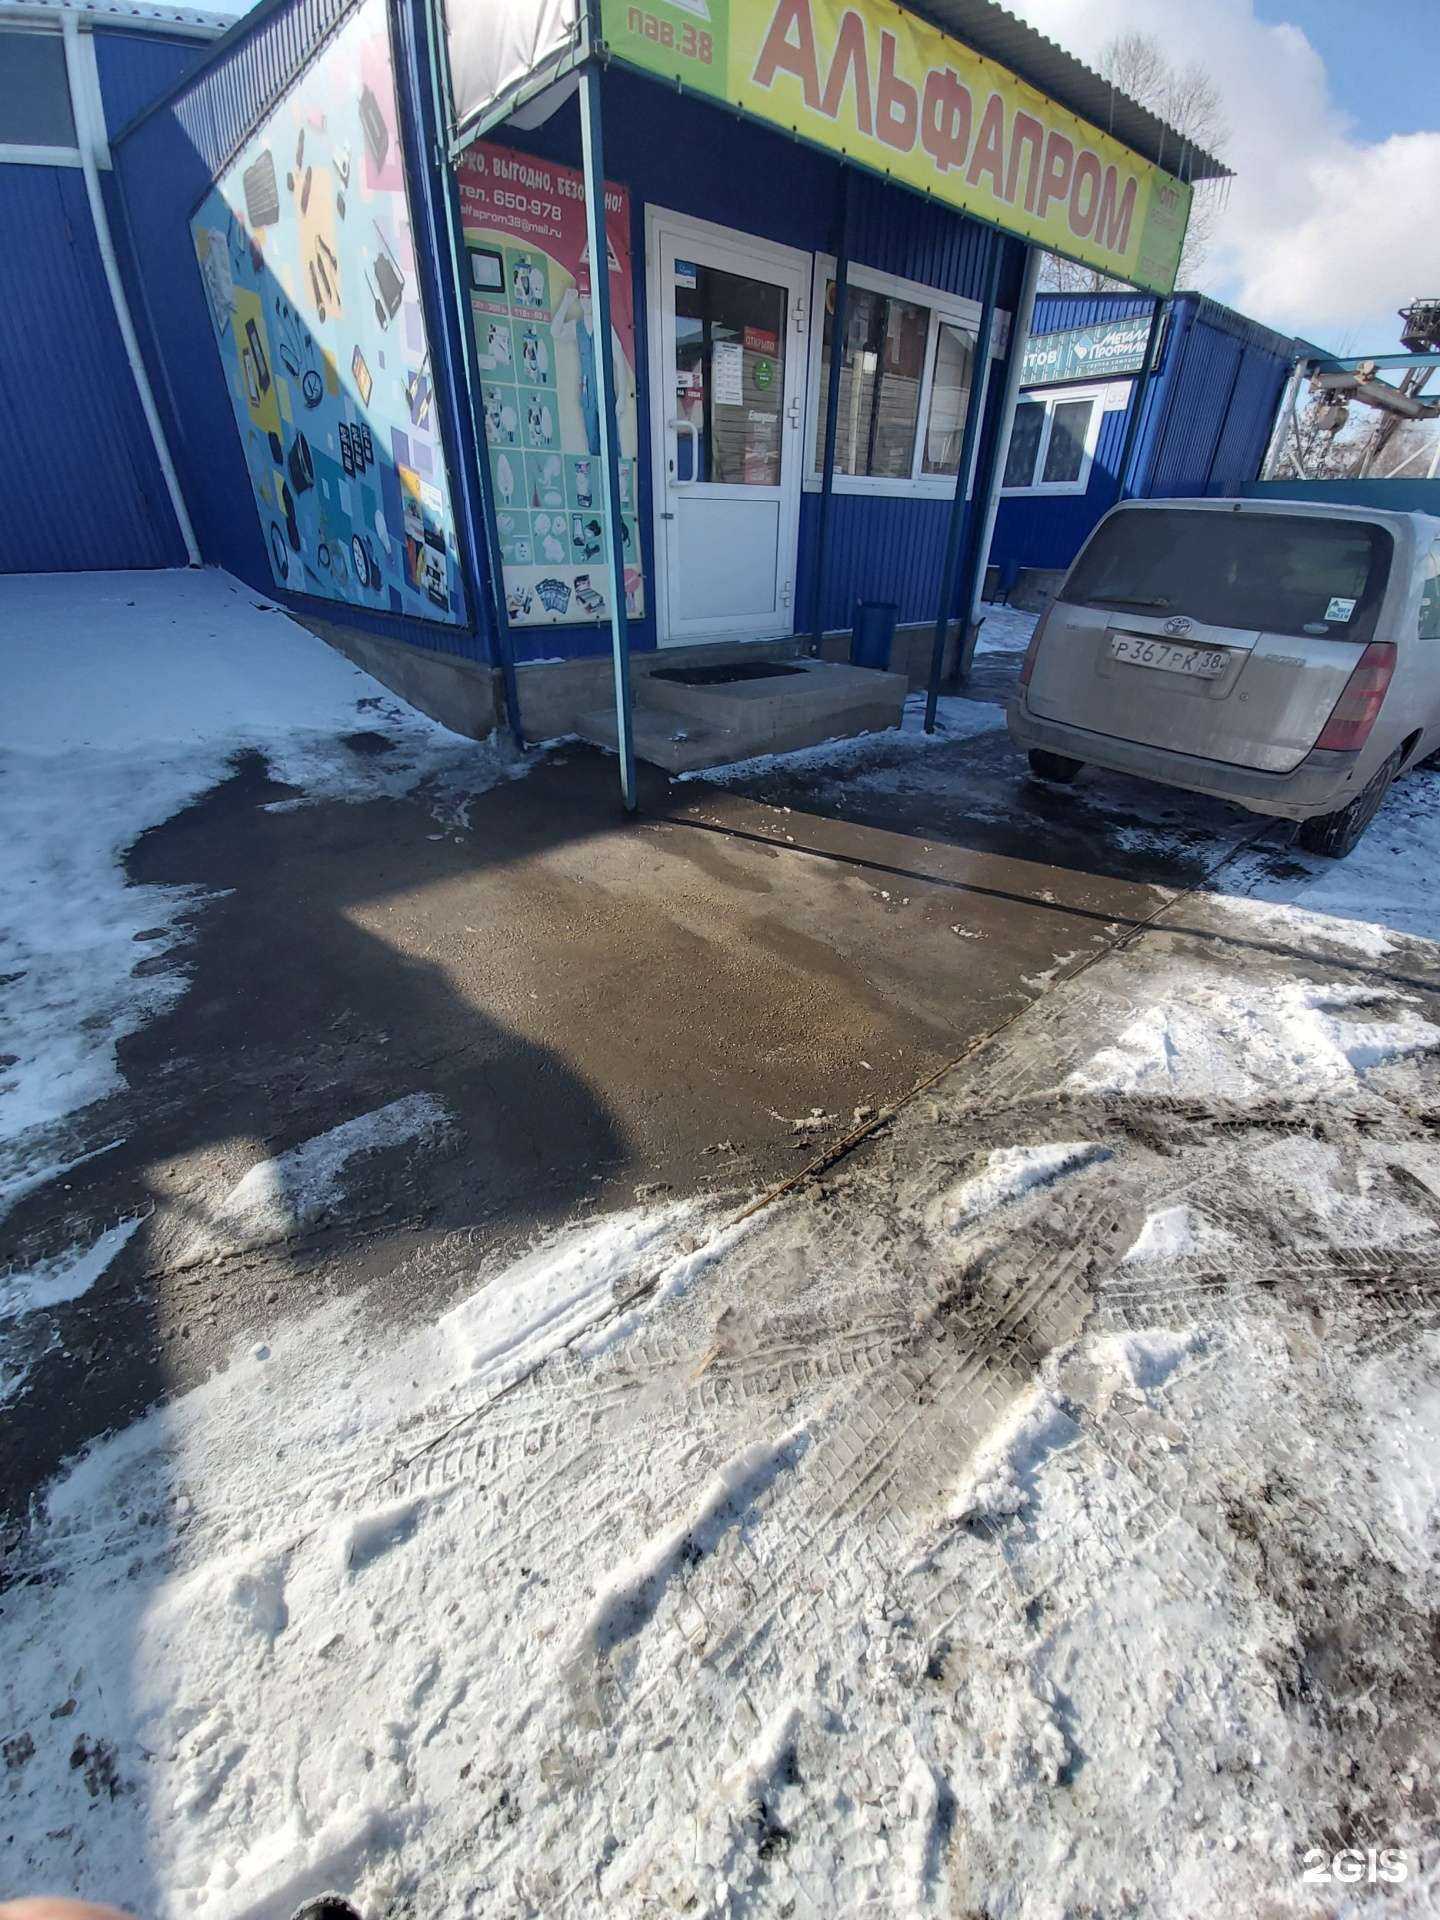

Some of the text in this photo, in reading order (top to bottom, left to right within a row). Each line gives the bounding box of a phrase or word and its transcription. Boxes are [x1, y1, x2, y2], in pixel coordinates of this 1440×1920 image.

[625, 6, 713, 65] пав.38
[752, 0, 1138, 257] АЛЬФАПРОМ
[493, 158, 555, 195] ВЫГОДНО,
[557, 177, 624, 214] БЕЗОНО!
[494, 190, 563, 221] 650-978
